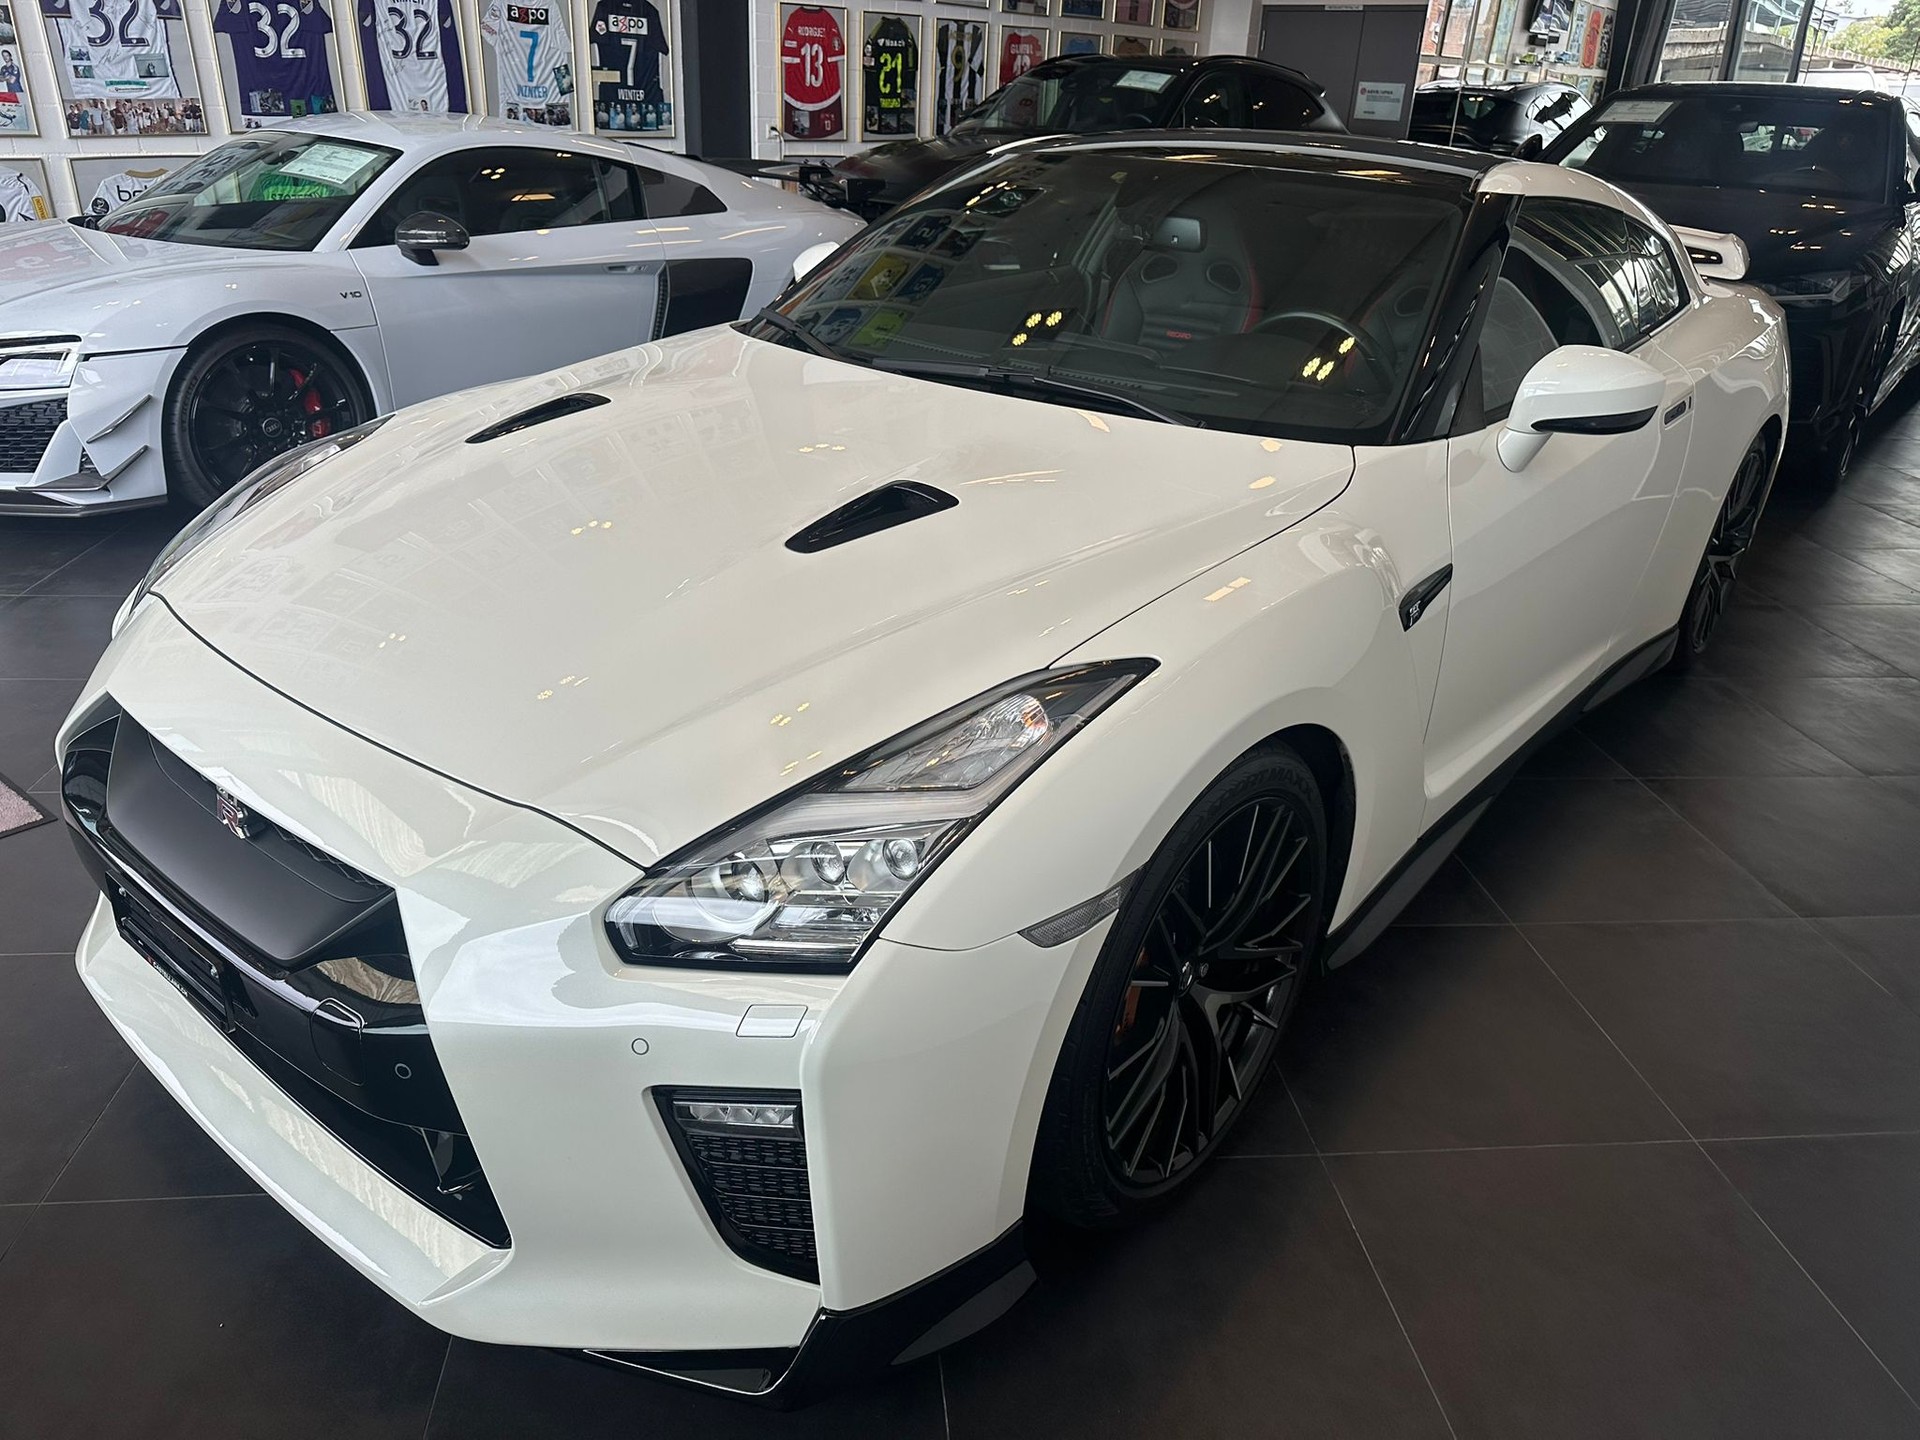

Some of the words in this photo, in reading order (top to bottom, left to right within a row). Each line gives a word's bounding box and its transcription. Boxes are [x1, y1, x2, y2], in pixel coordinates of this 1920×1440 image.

[86, 0, 151, 47] 32
[248, 2, 306, 58] 32
[387, 7, 438, 60] 32
[519, 30, 539, 82] 7
[620, 38, 638, 86] 7
[800, 42, 824, 88] 13
[879, 53, 902, 93] 21
[516, 84, 548, 98] WINTER
[617, 88, 645, 101] WINTER
